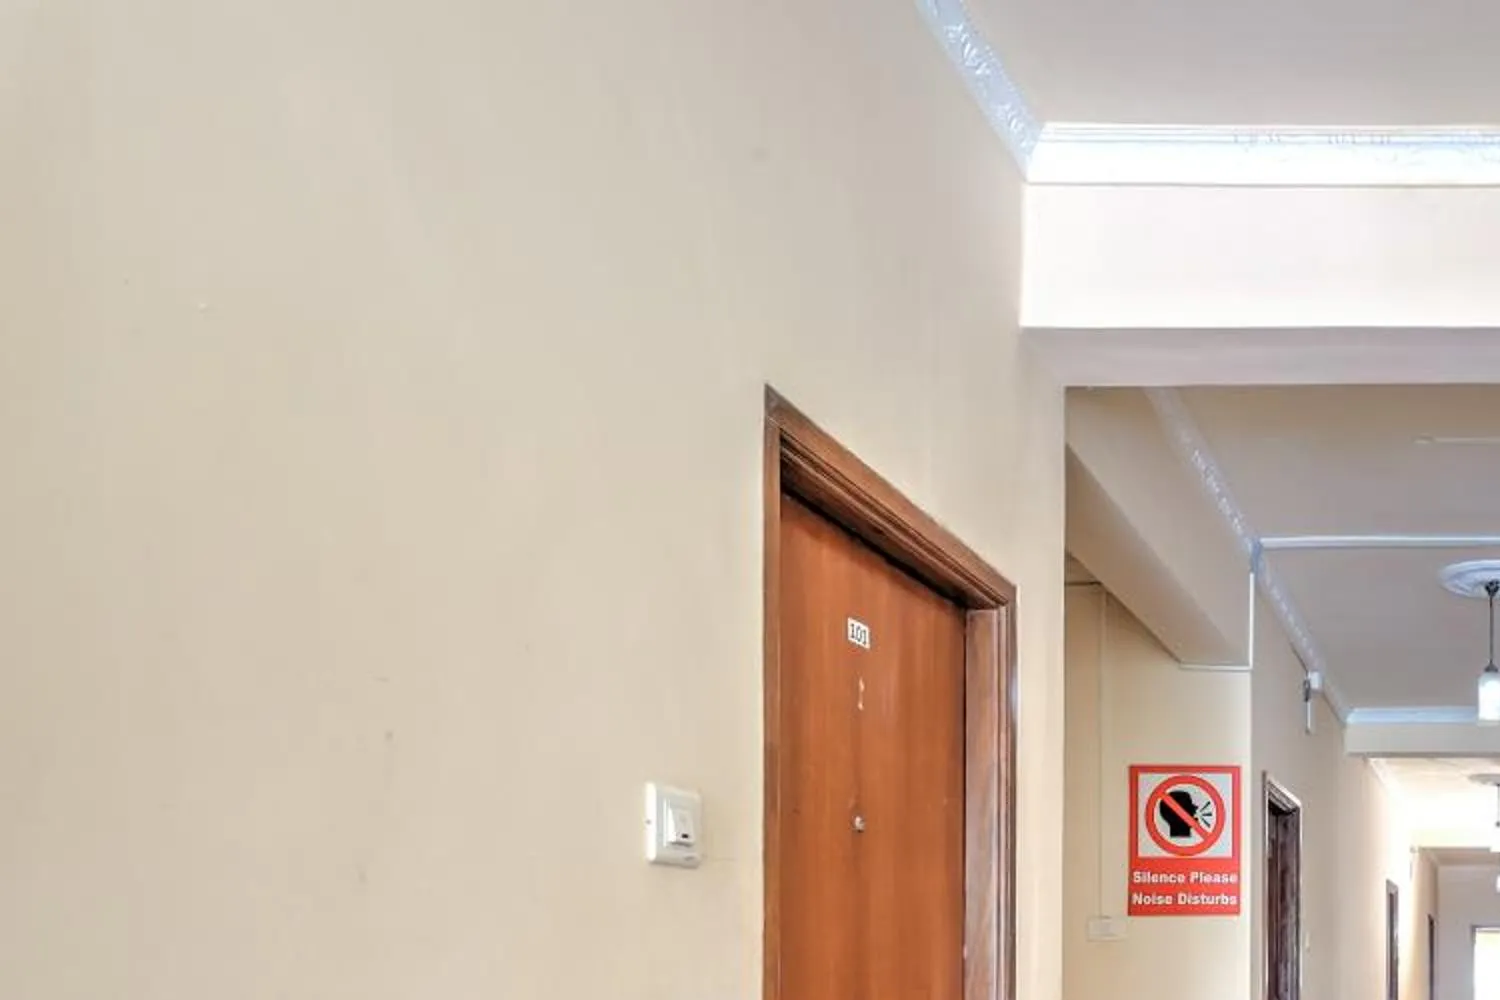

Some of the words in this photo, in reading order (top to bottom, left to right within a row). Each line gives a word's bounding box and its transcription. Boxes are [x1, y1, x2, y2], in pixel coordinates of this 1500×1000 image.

[1133, 871, 1185, 883] Silence
[1190, 871, 1238, 883] Please
[1132, 893, 1173, 905] Noise
[1177, 893, 1237, 905] Disturbs
